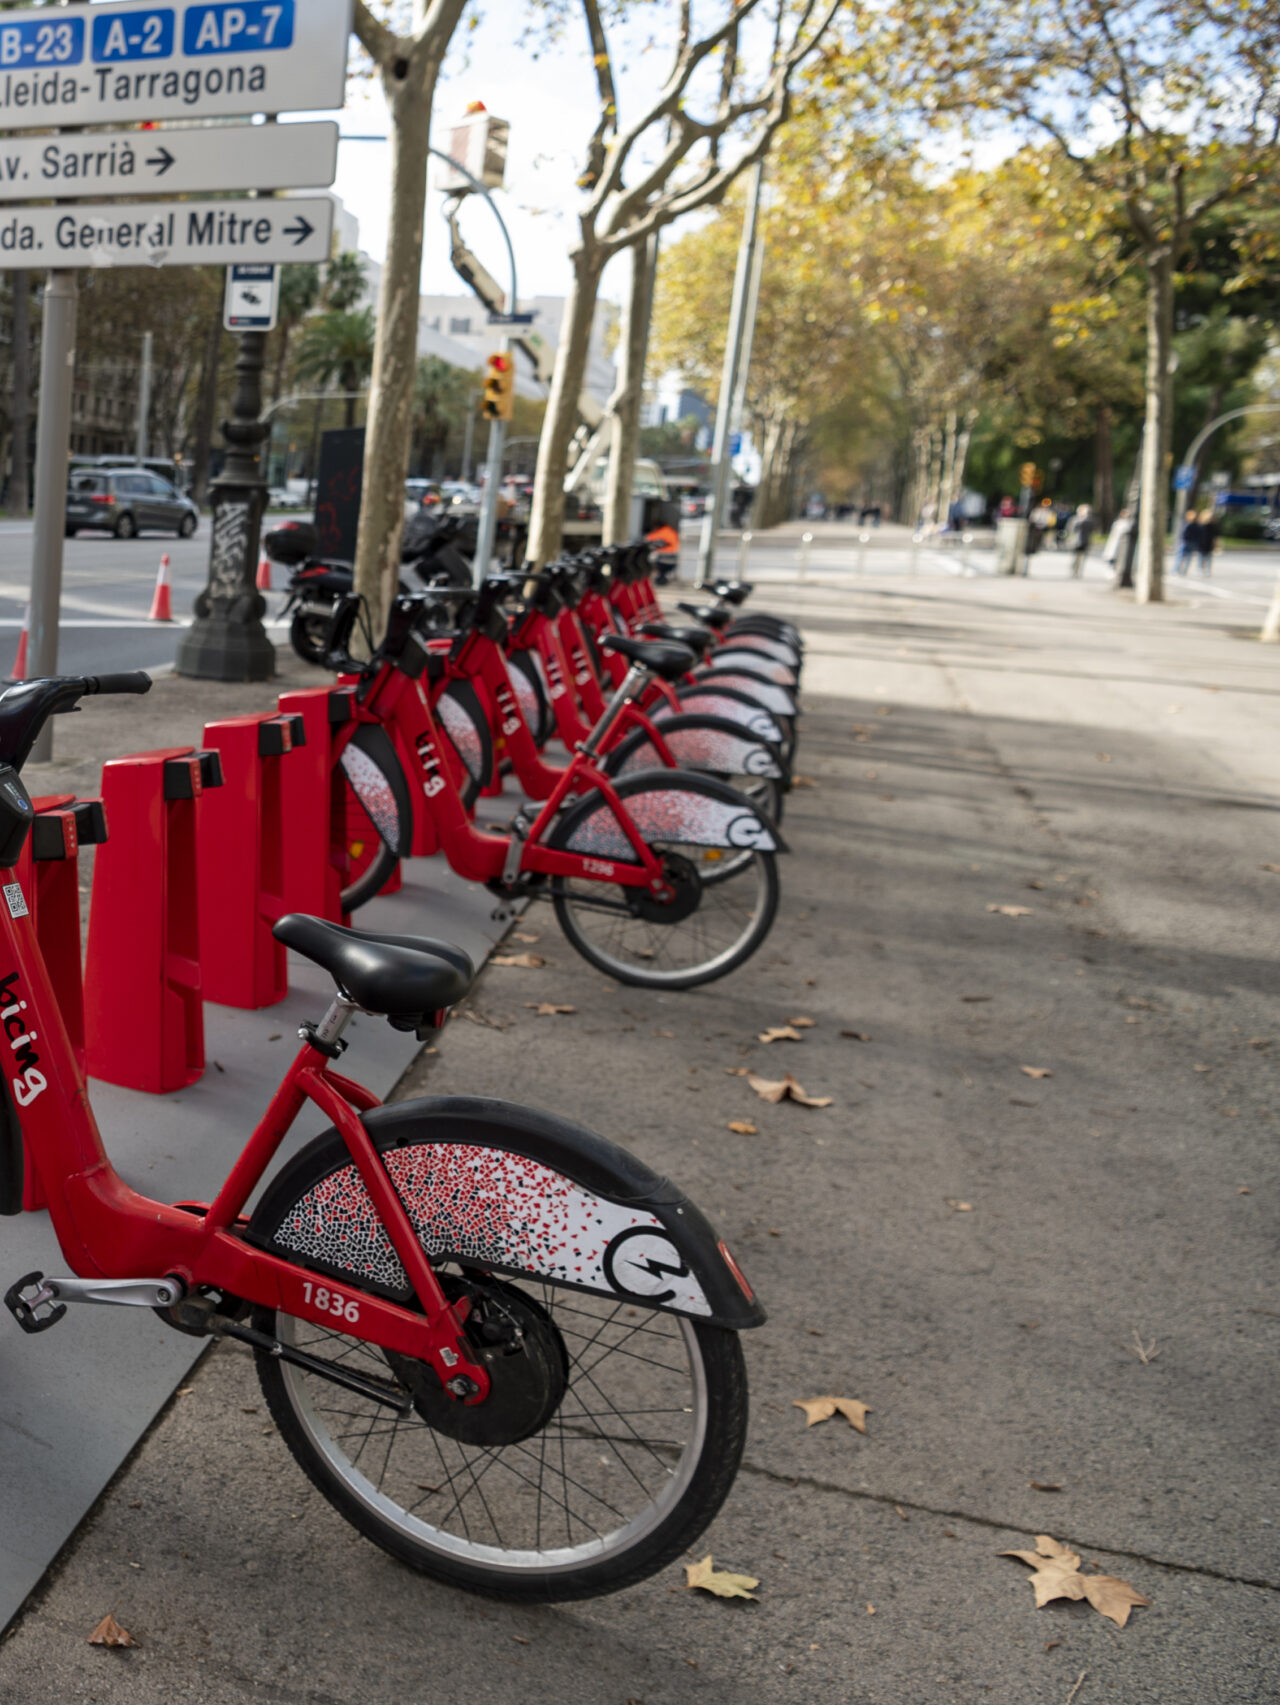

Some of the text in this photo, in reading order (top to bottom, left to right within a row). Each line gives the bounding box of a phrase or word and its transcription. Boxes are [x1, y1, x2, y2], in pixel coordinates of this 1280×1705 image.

[0, 5, 283, 65] B-23 A-2 AP-7
[41, 140, 136, 179] Sarrià
[56, 213, 175, 249] General
[187, 210, 272, 246] Mitre
[415, 730, 446, 798] bicing
[302, 1281, 360, 1324] 1836
